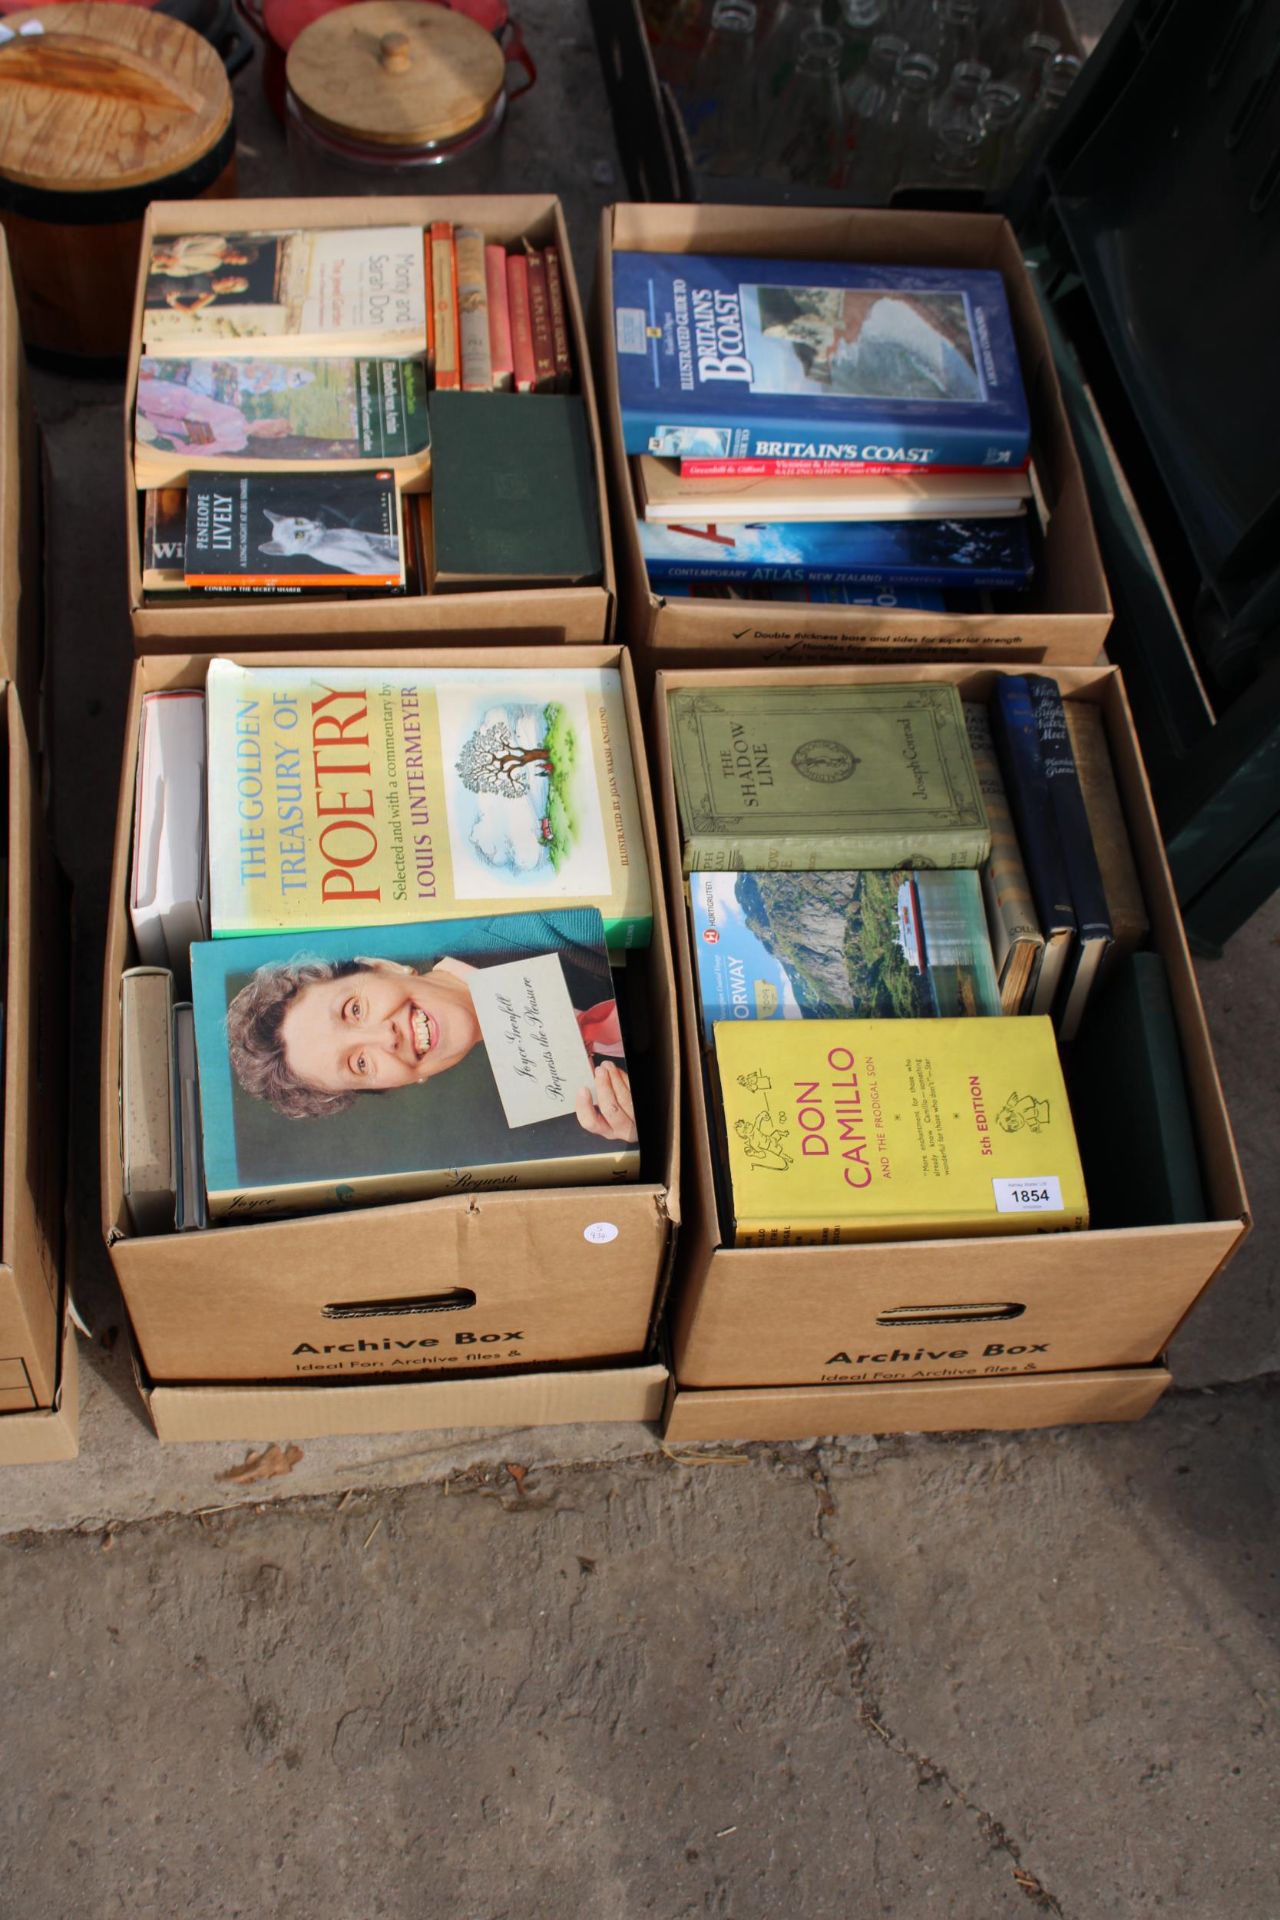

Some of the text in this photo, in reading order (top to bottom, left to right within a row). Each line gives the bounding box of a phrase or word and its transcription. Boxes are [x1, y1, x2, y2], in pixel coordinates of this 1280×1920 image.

[369, 255, 390, 325] Sarah Don
[392, 254, 415, 323] Monty and
[714, 289, 743, 355] COAST
[677, 326, 694, 391] ILLUSTRATED
[756, 441, 857, 459] BRITAIN'S
[861, 445, 933, 462] COAST
[196, 494, 210, 549] PENELOPE
[213, 493, 233, 550] LIVELY
[152, 541, 184, 559] Wi
[668, 568, 748, 578] CONTEMPORARY
[751, 568, 804, 581] ATLAS
[808, 573, 832, 581] NEW
[835, 573, 882, 582] ZEALAND
[938, 635, 979, 644] superior
[982, 636, 1023, 644] strength
[378, 682, 392, 697] by
[381, 699, 397, 778] commentary
[897, 719, 928, 800] Joseph Conrad
[720, 749, 735, 778] THE
[729, 721, 759, 807] SHADOW
[752, 743, 774, 786] LINE
[236, 698, 266, 886] THE GOLDEN
[273, 692, 307, 896] TREASURY OF
[311, 679, 381, 904] POETRY
[386, 791, 401, 818] with
[400, 684, 437, 899] LOUIS UNTERMEYER
[599, 706, 630, 867] ILLUSTRATED BY JOAN WALSH ANGLUND
[388, 820, 404, 843] and
[392, 845, 408, 901] Selected
[705, 881, 716, 926] HURTIGRUTEN
[728, 956, 749, 1019] ORWAY
[495, 992, 537, 1083] Joyce Grenfell
[523, 977, 567, 1102] Requests the Pleasure
[905, 1059, 913, 1072] who
[794, 1082, 829, 1156] DON
[827, 1047, 872, 1188] CAMILLO
[865, 1056, 892, 1179] AND THE PRODIGAL SON
[914, 1111, 927, 1151] enchantment
[934, 1115, 942, 1131] those
[969, 1075, 992, 1156] 5th EDITION
[927, 1130, 935, 1147] know
[940, 1144, 950, 1175] wonderful
[446, 1172, 520, 1191] Requests
[932, 1155, 941, 1177] already
[224, 1192, 276, 1211] Joyce
[1012, 1189, 1050, 1202] 1854
[291, 1330, 525, 1356] Archive Box
[296, 1362, 343, 1371] Ideal
[391, 1355, 458, 1366] Archive
[466, 1352, 501, 1361] files
[508, 1349, 522, 1358] &
[825, 1342, 1052, 1365] Archive Box
[821, 1373, 866, 1381] Ideal
[911, 1367, 977, 1377] Archive
[984, 1365, 1018, 1373] files
[1023, 1362, 1037, 1371] &
